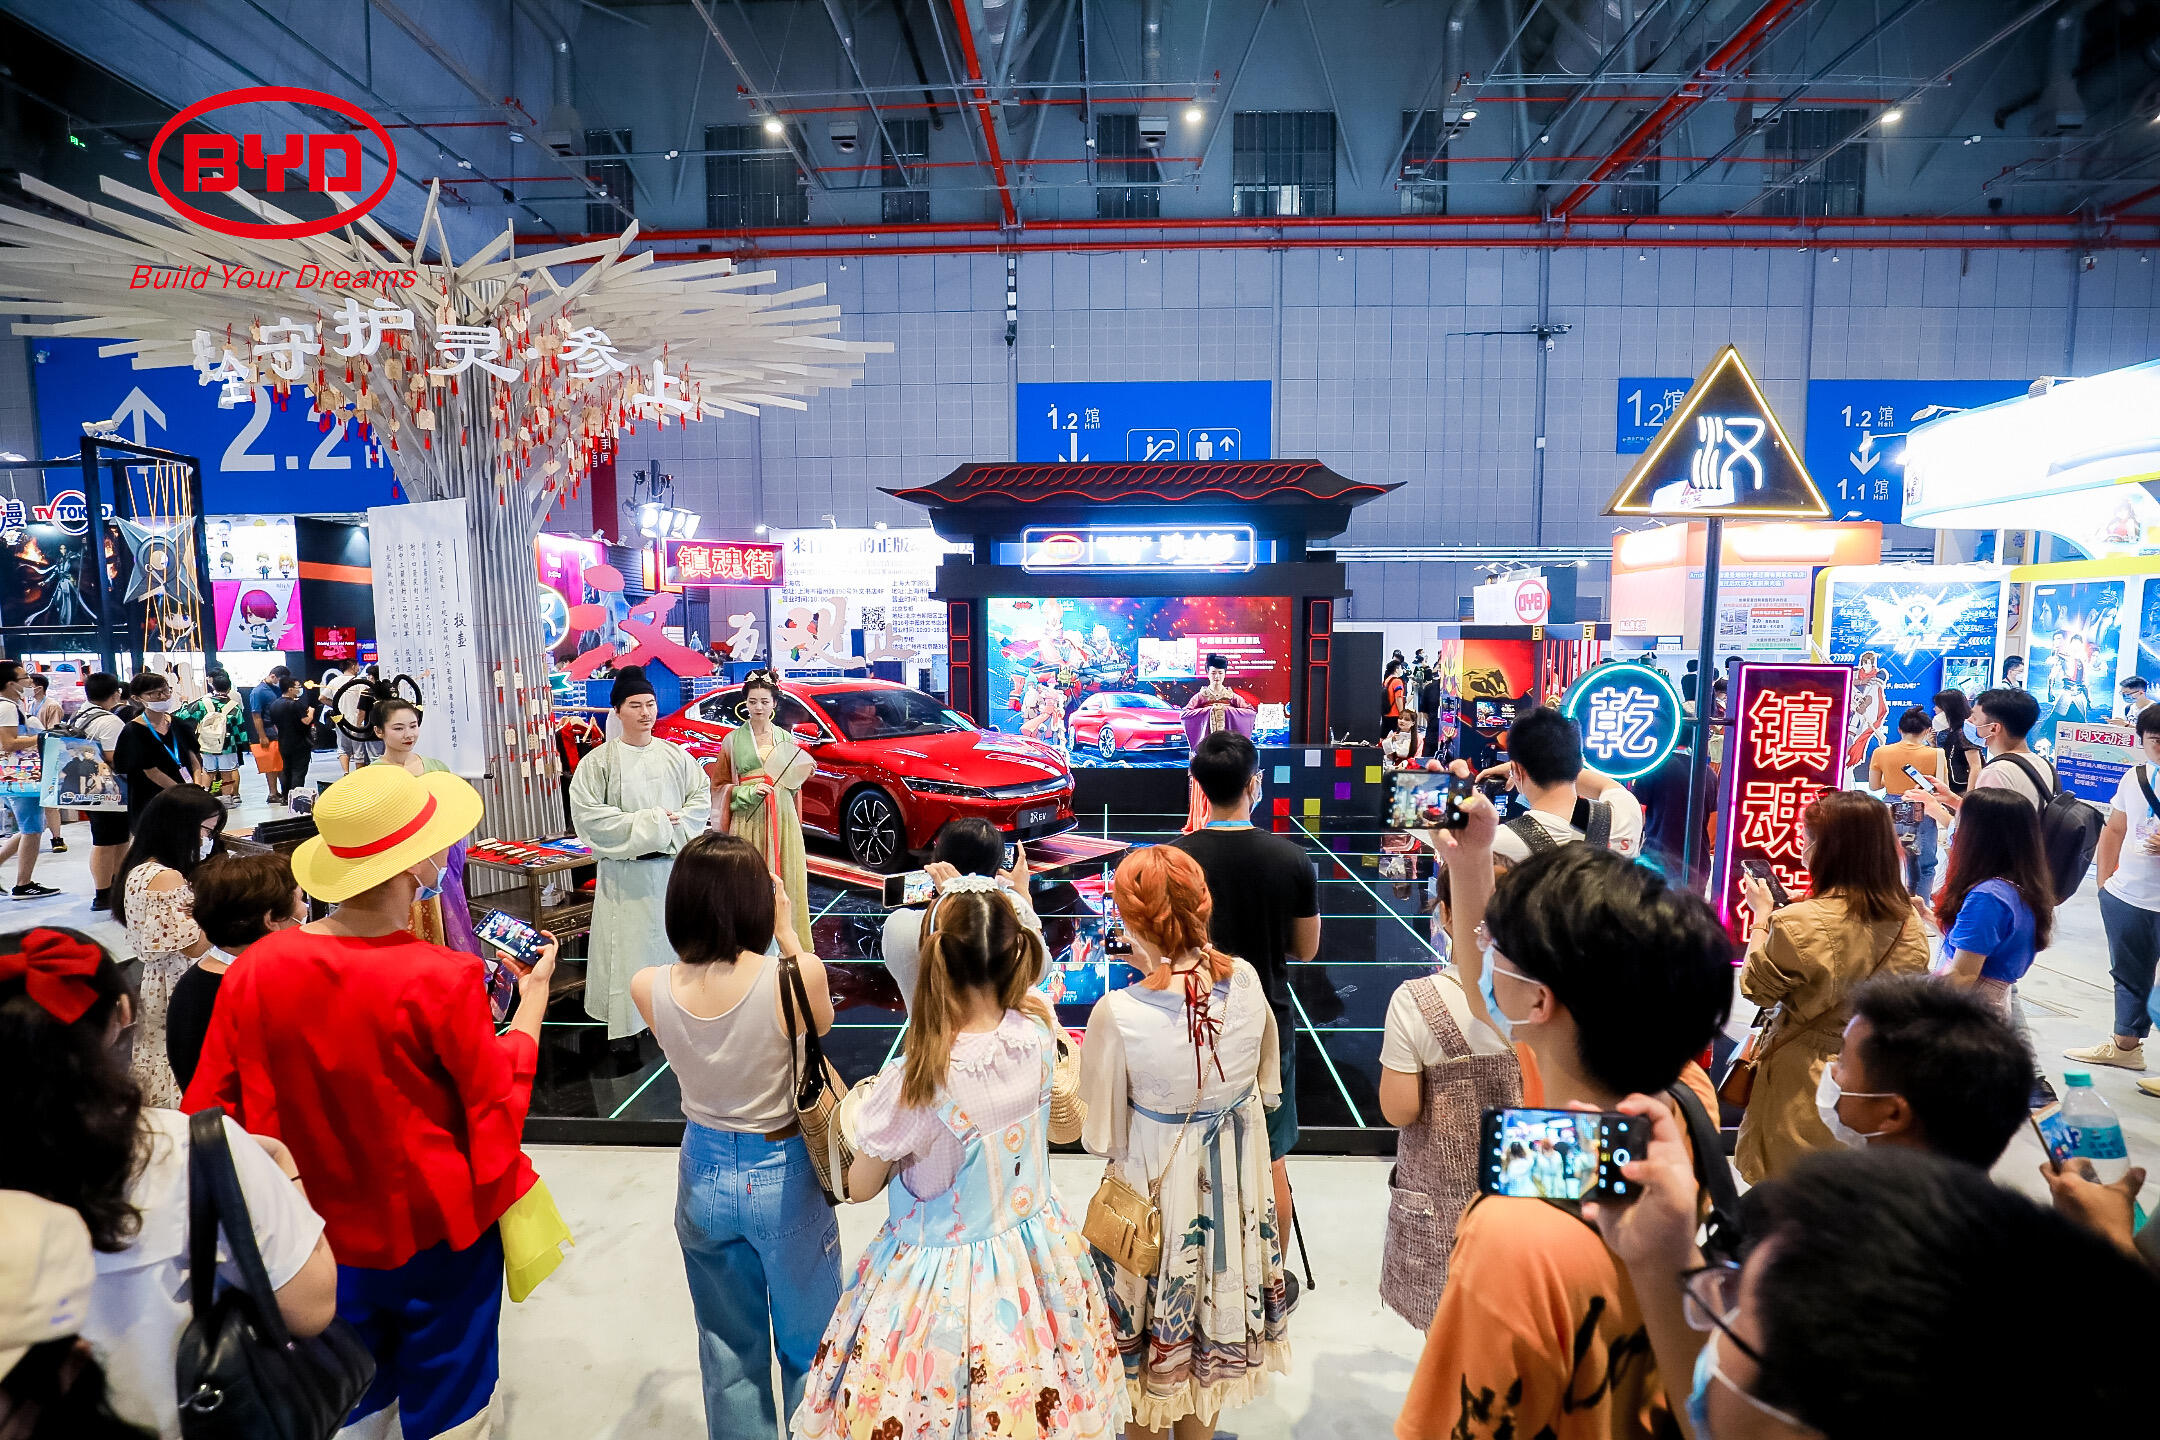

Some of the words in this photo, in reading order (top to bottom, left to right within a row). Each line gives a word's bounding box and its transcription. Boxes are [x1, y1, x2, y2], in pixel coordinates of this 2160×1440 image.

[1047, 407, 1078, 430] 1.2
[1084, 407, 1099, 423] 馆
[1627, 389, 1664, 427] 1.2
[1841, 405, 1872, 427] 1.2
[1879, 405, 1894, 421] 馆
[1085, 422, 1100, 430] Hall
[1837, 478, 1866, 500] 1.1
[1874, 479, 1889, 495] 馆
[34, 508, 54, 520] TV
[57, 506, 109, 520] TOKO
[676, 544, 774, 580] 镇魂街
[1587, 686, 1659, 759] 乾
[2078, 730, 2132, 747] 阅文动漫
[1734, 689, 1833, 943] 镇魂
